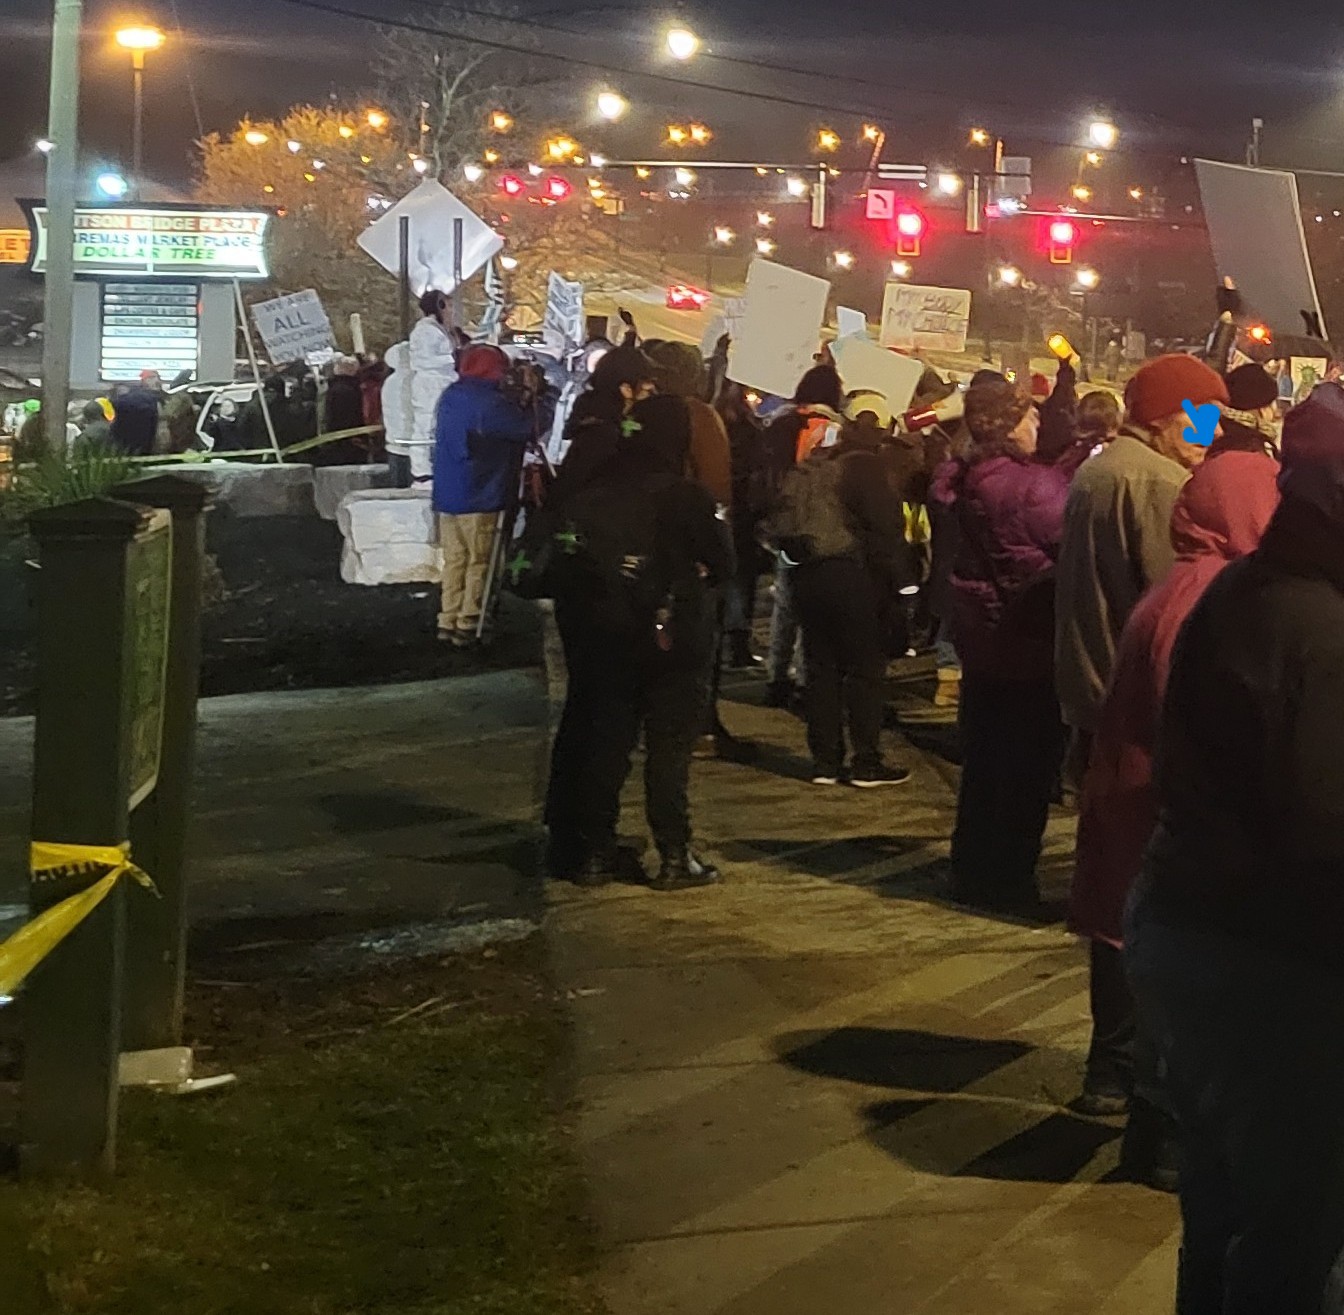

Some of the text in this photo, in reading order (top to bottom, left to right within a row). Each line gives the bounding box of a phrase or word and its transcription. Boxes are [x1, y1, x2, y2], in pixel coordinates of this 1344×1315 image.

[83, 246, 216, 260] DOLLAR TREE
[274, 311, 312, 333] ALL
